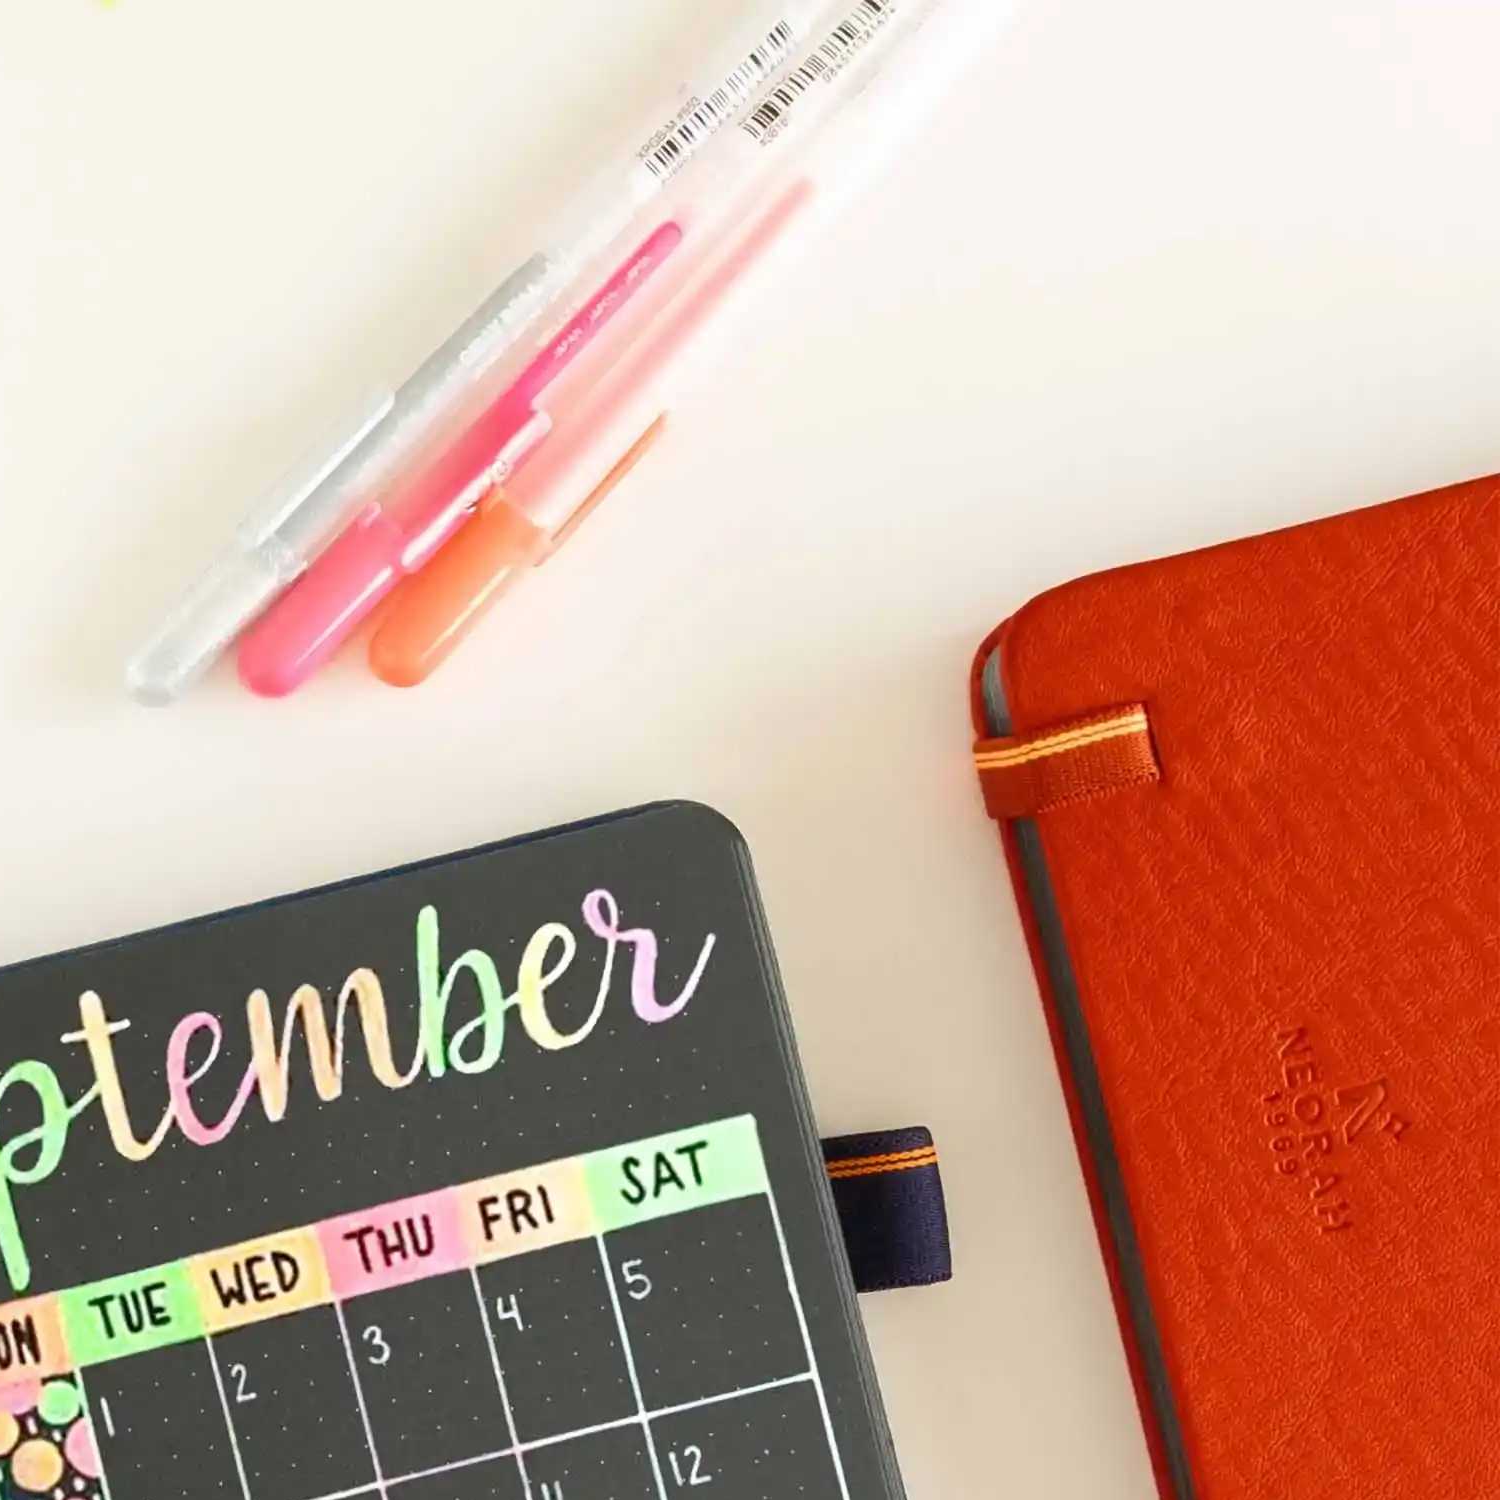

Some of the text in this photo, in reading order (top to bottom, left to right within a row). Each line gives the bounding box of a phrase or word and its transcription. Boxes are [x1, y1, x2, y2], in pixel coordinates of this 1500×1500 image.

[1272, 1028, 1354, 1236] NEORAH
[87, 1282, 172, 1340] TUE
[210, 1251, 300, 1309] WED
[343, 1214, 435, 1274] THU
[478, 1185, 554, 1241] FRI
[619, 1141, 709, 1205] SAT
[100, 1258, 653, 1437] 1 2 3 4 5
[668, 1444, 712, 1487] 12
